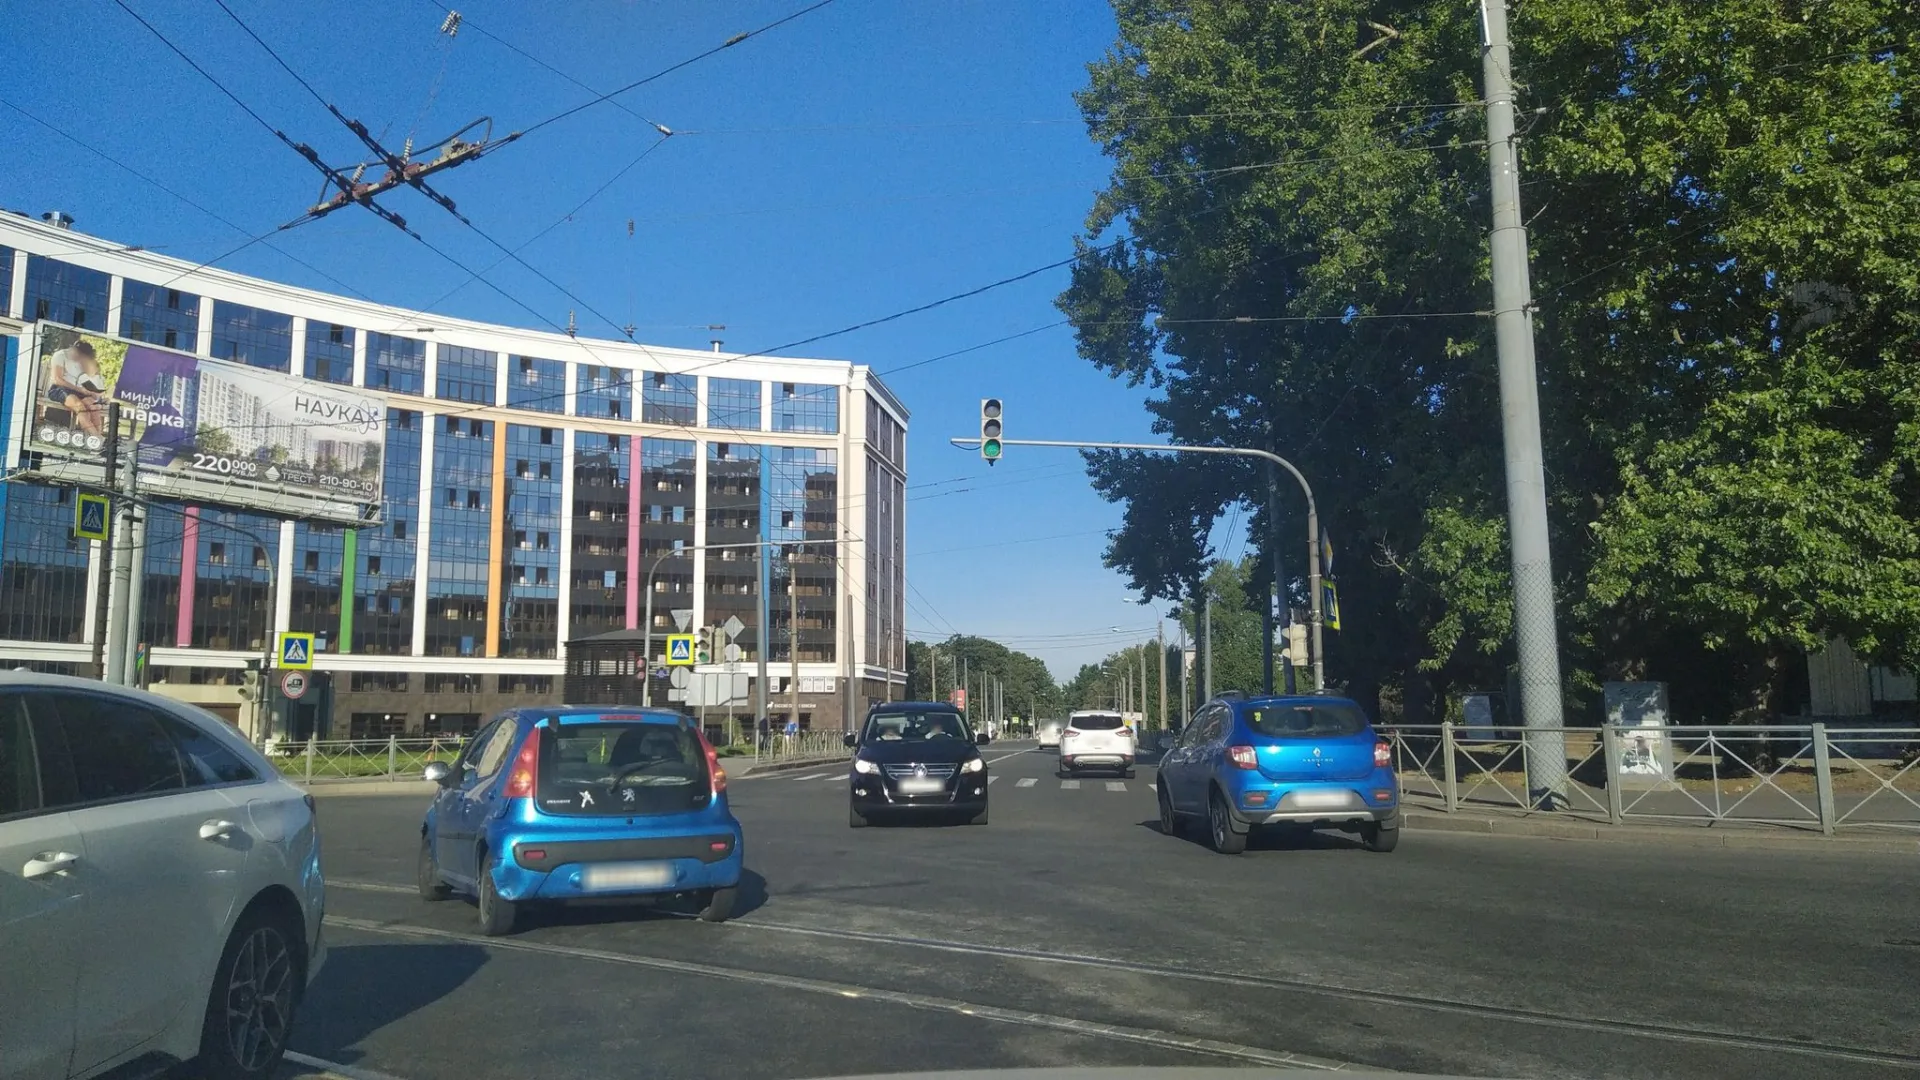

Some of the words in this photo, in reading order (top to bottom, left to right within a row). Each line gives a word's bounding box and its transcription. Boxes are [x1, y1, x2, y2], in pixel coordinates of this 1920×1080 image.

[121, 390, 168, 407] минут
[137, 402, 150, 410] до
[122, 407, 185, 428] парка
[295, 395, 365, 425] НАУКА
[280, 470, 313, 484] ТРЕСТ
[319, 474, 373, 492] 210-90-10
